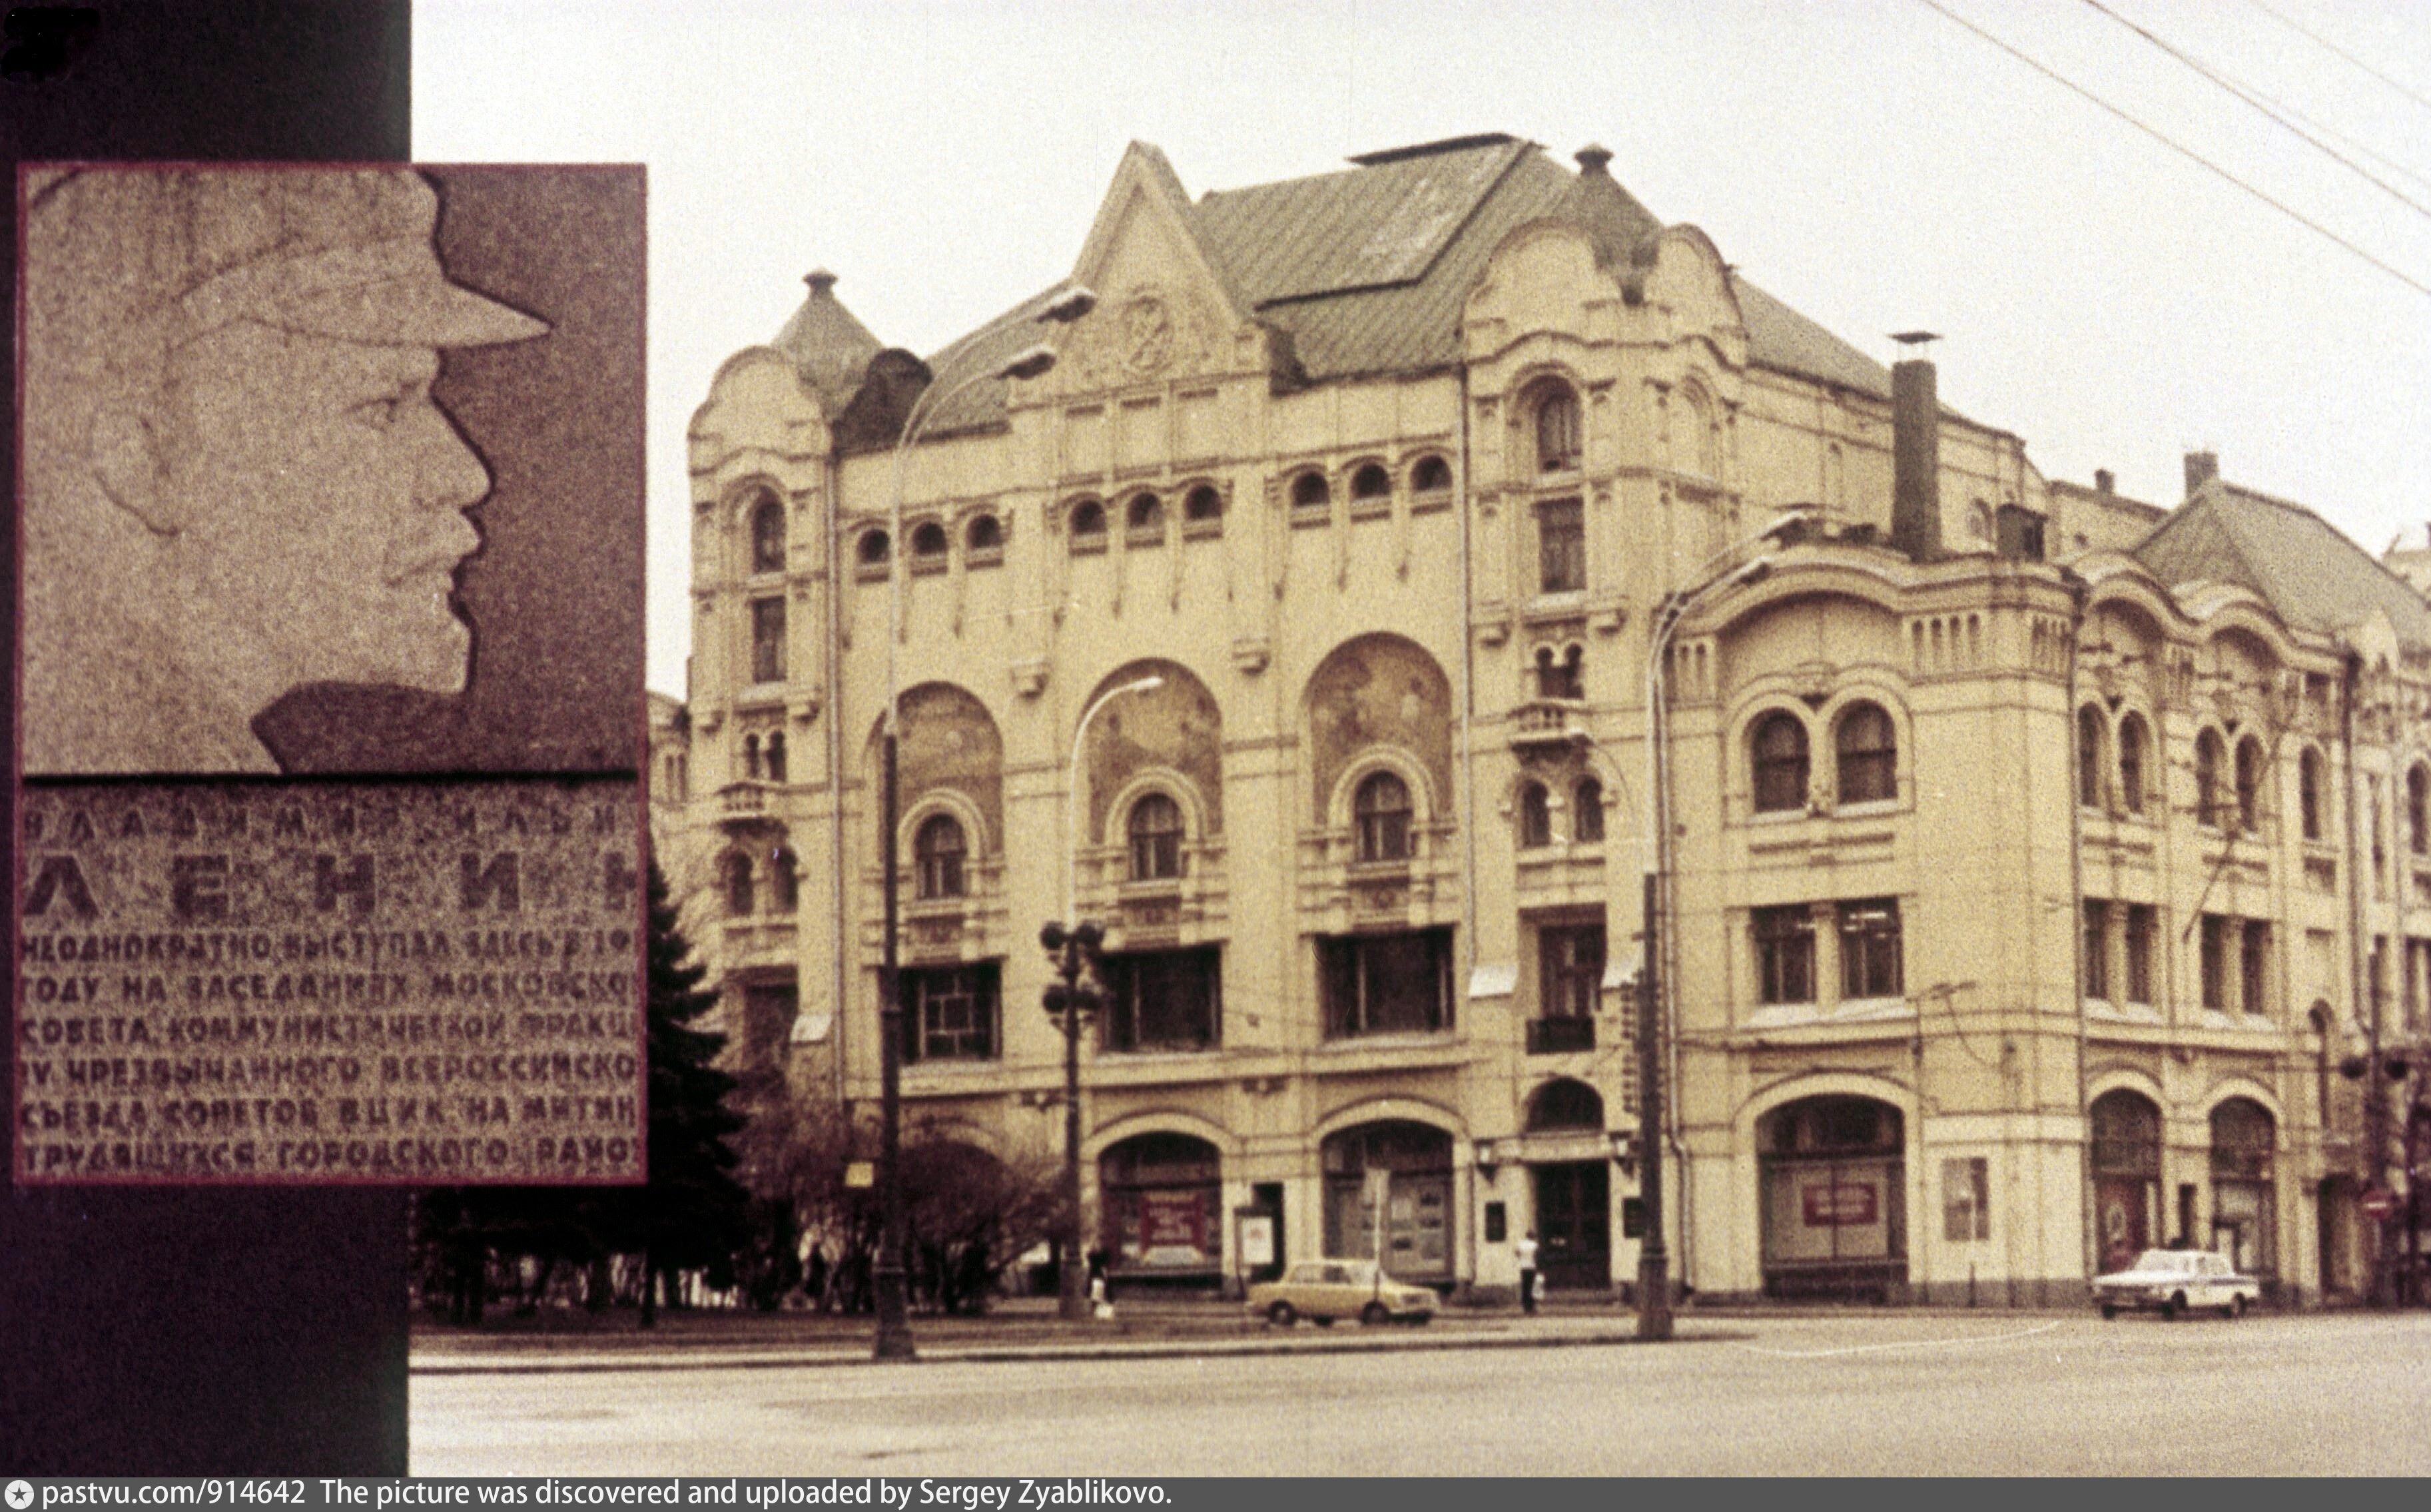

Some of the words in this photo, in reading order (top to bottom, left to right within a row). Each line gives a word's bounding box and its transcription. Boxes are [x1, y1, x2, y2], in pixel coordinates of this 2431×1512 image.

[123, 974, 166, 1002] НА
[431, 970, 638, 1000] МОСКОВСКО
[467, 1096, 509, 1126] НА
